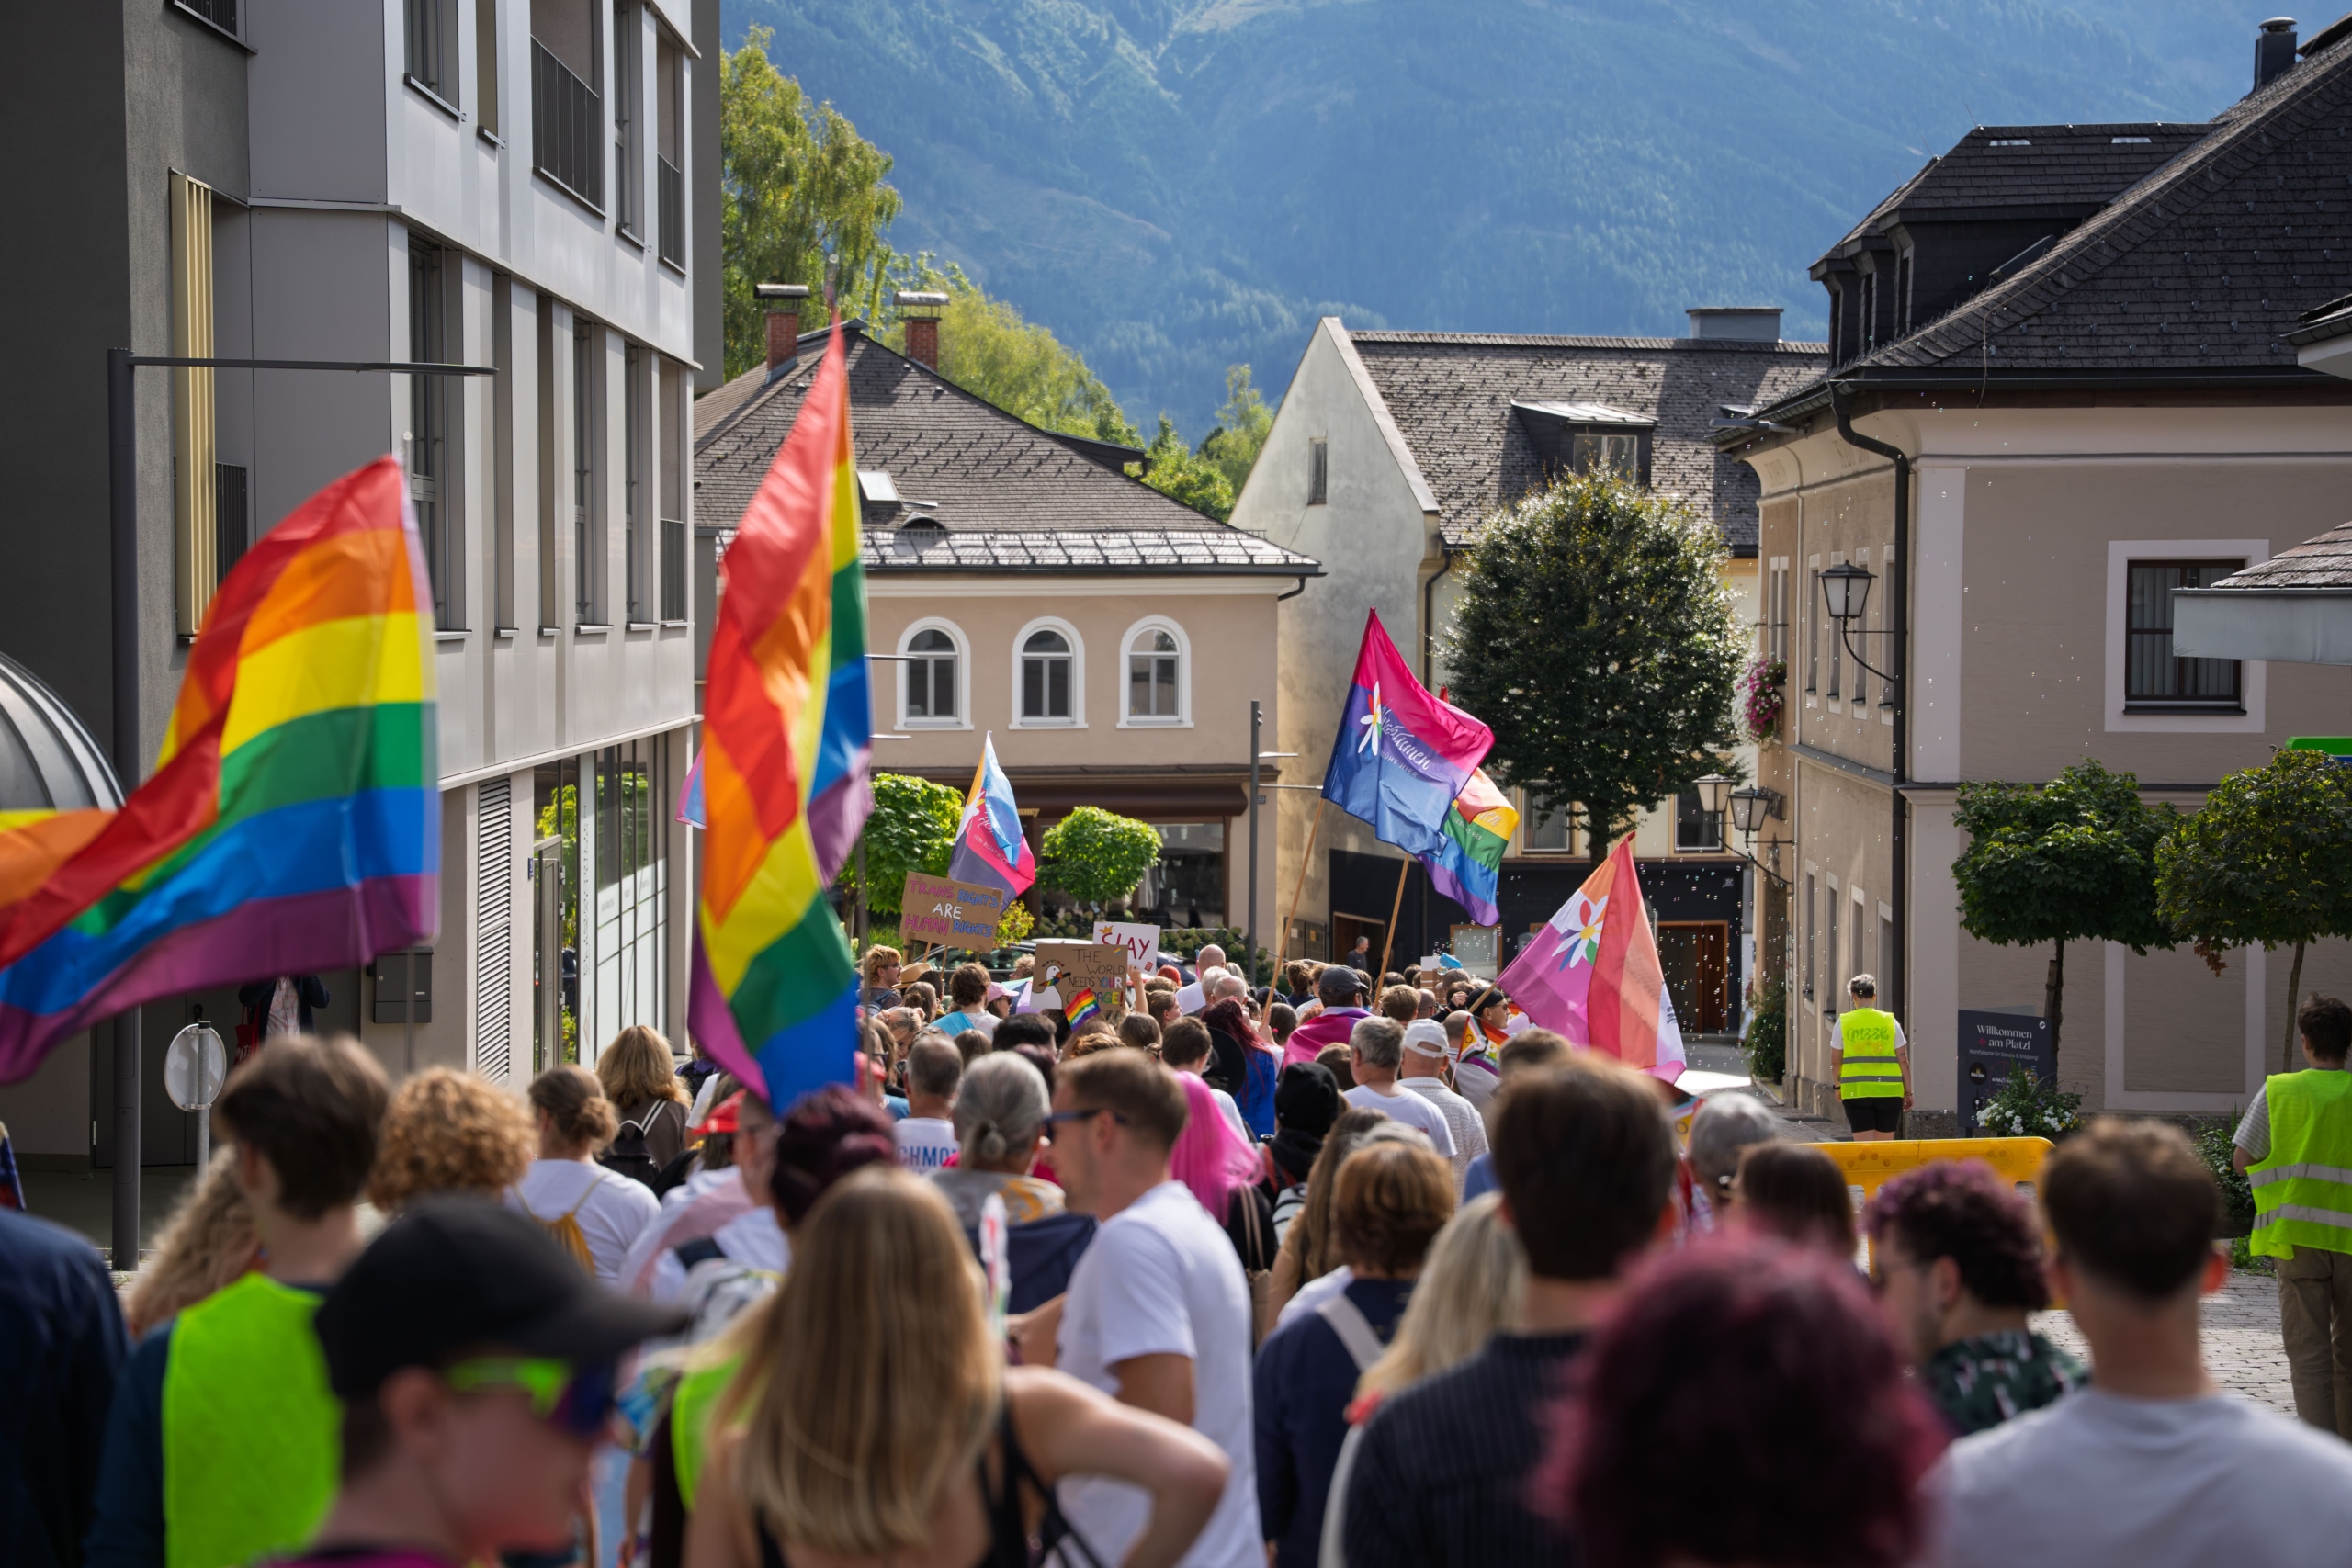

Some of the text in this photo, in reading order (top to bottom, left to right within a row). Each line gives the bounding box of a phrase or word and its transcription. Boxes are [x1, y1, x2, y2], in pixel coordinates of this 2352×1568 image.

[1398, 762, 1419, 779] HIER
[910, 879, 999, 908] TRANS RIGHTS
[932, 903, 963, 919] ARE
[905, 914, 993, 937] HUMAN RIGHTS
[1070, 948, 1102, 963] THE
[1086, 964, 1125, 975] WORLD
[1069, 976, 1123, 988] NEEDS YOUR
[1976, 1024, 2032, 1039] Willkommen
[1988, 1039, 2030, 1050] am Platzl
